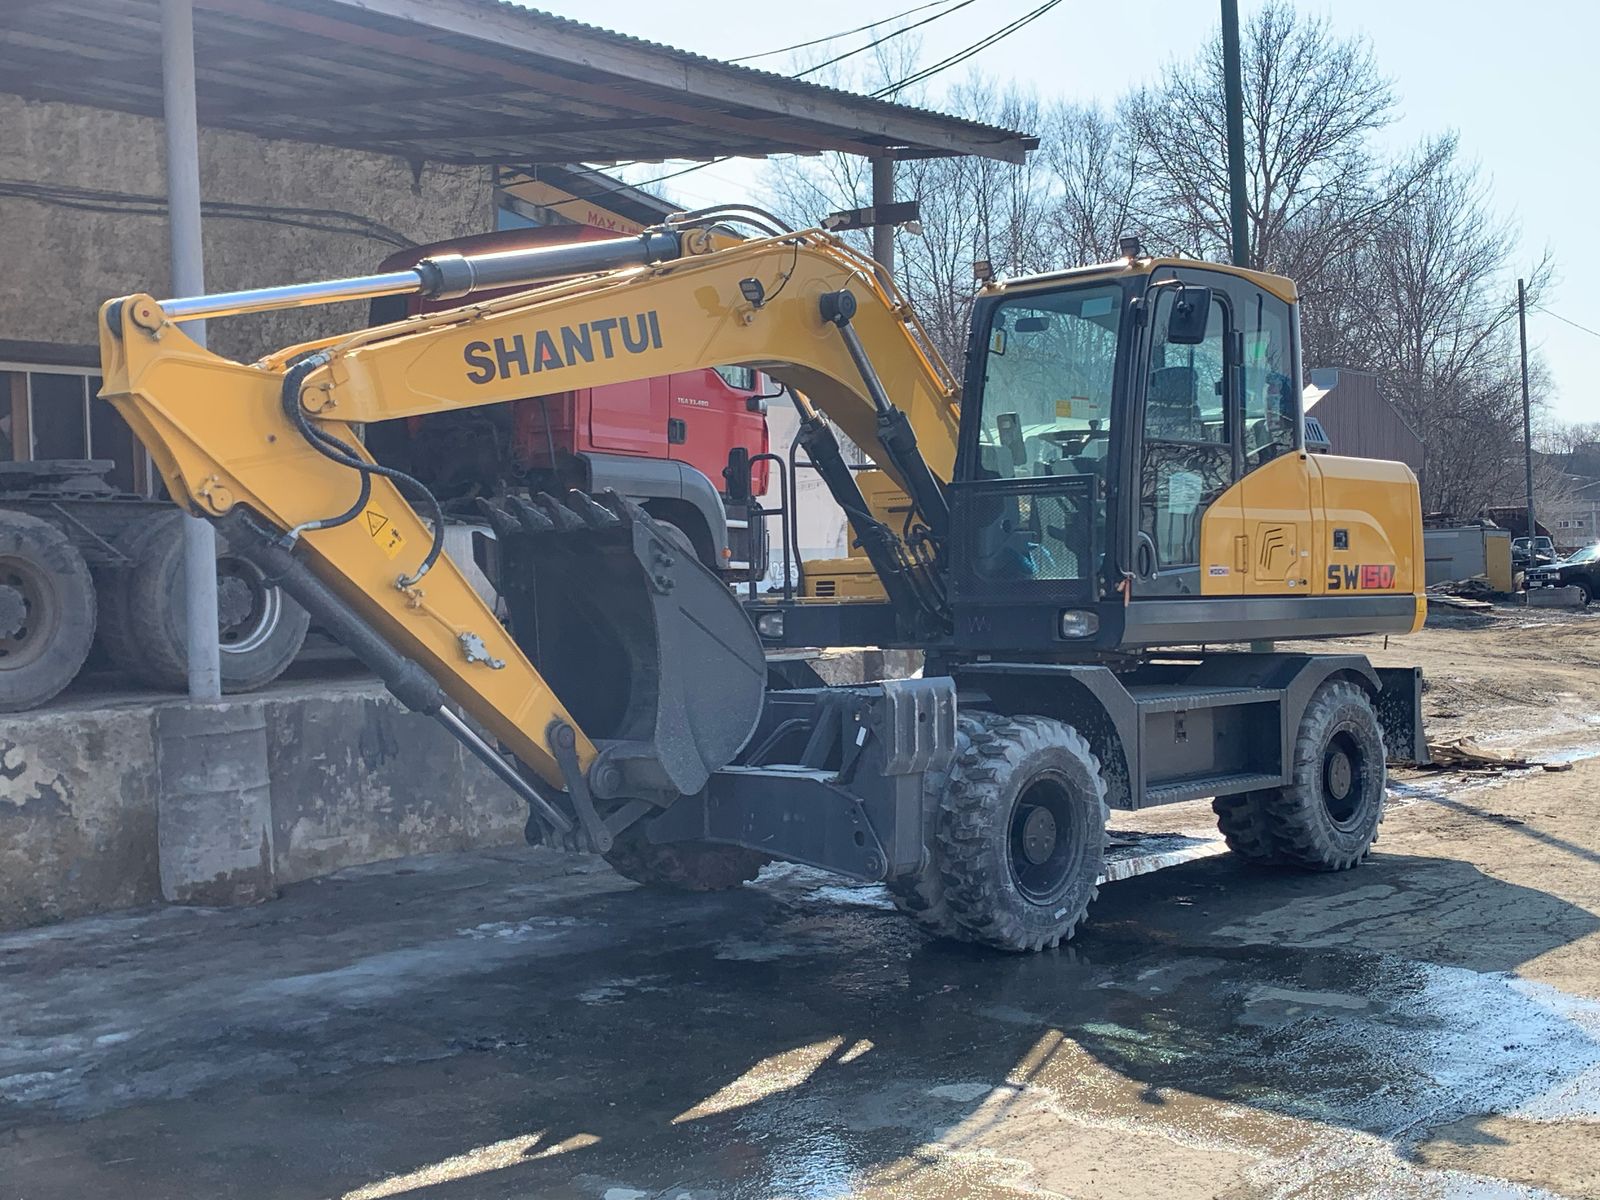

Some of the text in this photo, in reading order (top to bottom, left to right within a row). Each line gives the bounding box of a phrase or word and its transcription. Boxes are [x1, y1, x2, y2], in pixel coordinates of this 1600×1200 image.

[588, 211, 616, 230] MAX
[463, 310, 663, 385] SHANTUI
[1328, 564, 1392, 590] SW150
